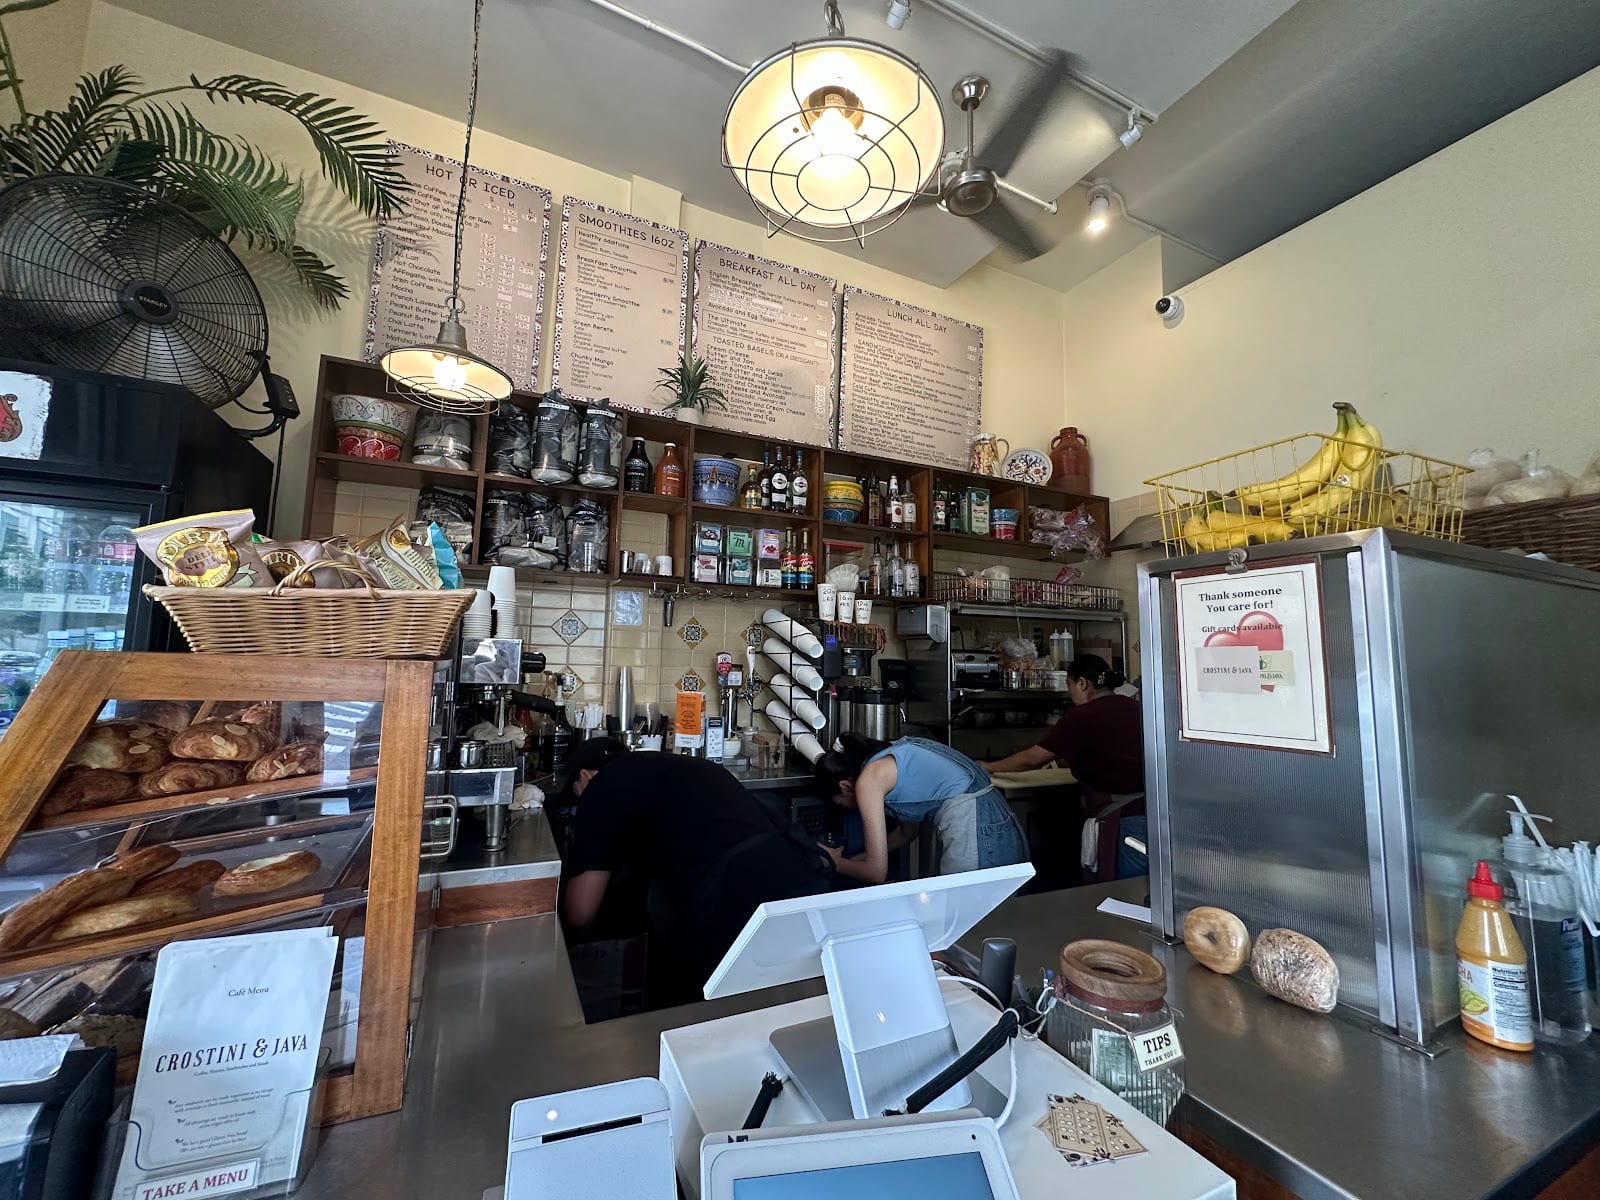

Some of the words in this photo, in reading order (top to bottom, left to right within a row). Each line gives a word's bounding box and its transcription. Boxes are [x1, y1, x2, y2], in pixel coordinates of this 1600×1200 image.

[425, 164, 452, 180] HOT
[483, 182, 515, 200] ICED
[578, 213, 646, 241] SMOOTHIES
[719, 257, 773, 281] BREAKFAST
[777, 274, 796, 287] ALL
[800, 281, 816, 293] DAY
[887, 309, 912, 323] LUNCH
[915, 317, 930, 328] ALL
[933, 323, 946, 333] DAY
[419, 332, 439, 341] Latt
[712, 336, 744, 349] TOASTED
[747, 344, 774, 356] BAGELS
[159, 530, 228, 561] DIRTY
[1198, 591, 1230, 602] Thank
[1232, 587, 1282, 599] someone
[1206, 604, 1226, 613] You
[1227, 603, 1251, 611] care
[1253, 600, 1274, 610] for!
[1202, 624, 1216, 633] Gift
[1218, 624, 1241, 633] cards
[1242, 622, 1283, 632] available
[228, 987, 246, 998] Café
[248, 985, 269, 995] Menu
[155, 1042, 248, 1074] CROSTINI
[252, 1037, 269, 1058] &
[271, 1034, 309, 1057] JAVA
[1143, 1032, 1171, 1054] TIPS
[1145, 1054, 1164, 1066] THANK
[1164, 1051, 1174, 1060] YOU
[143, 1181, 187, 1200] TAKE
[188, 1179, 199, 1193] A
[203, 1168, 249, 1190] MENU
